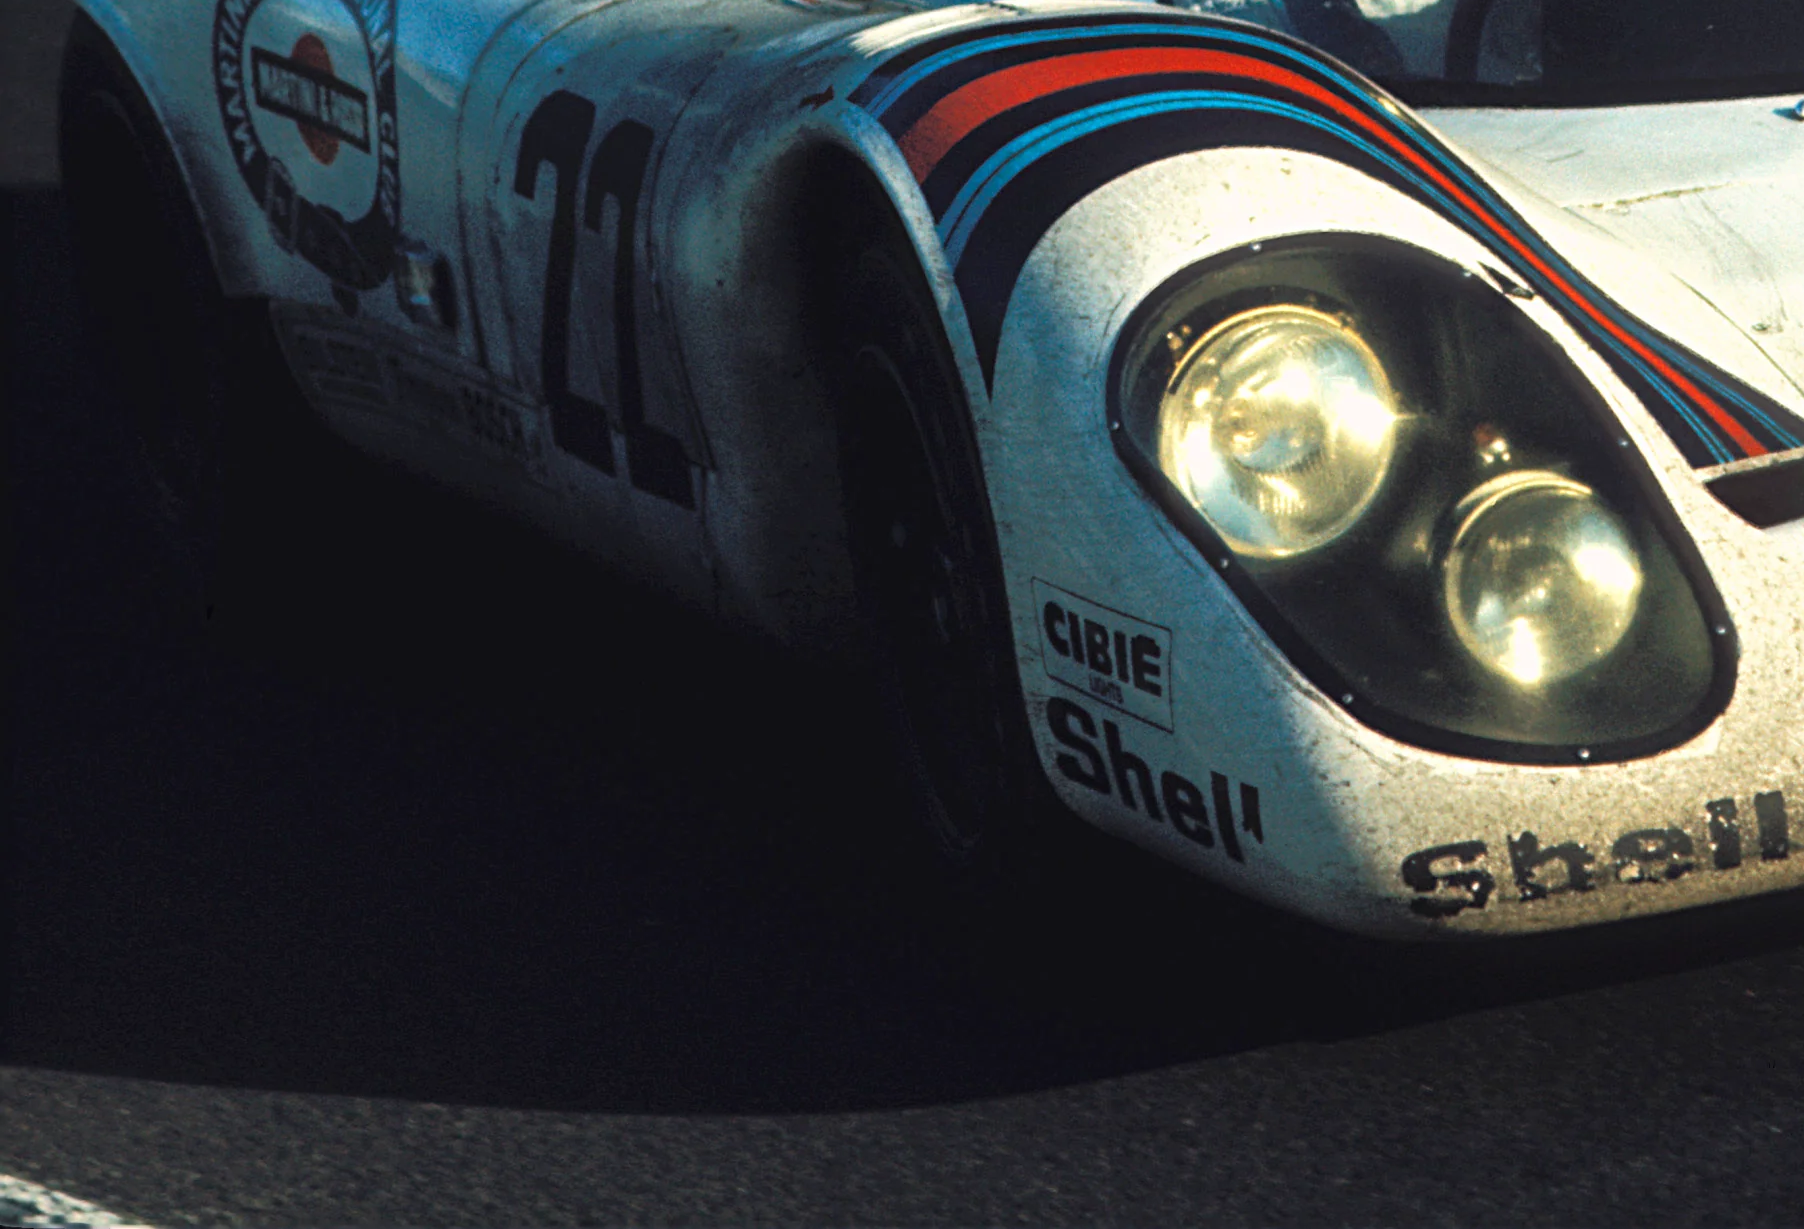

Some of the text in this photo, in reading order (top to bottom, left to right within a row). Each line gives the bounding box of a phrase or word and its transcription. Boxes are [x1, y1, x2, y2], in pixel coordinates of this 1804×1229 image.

[513, 87, 698, 512] 22
[1046, 696, 1264, 864] Shell
[1401, 789, 1790, 919] Shell
